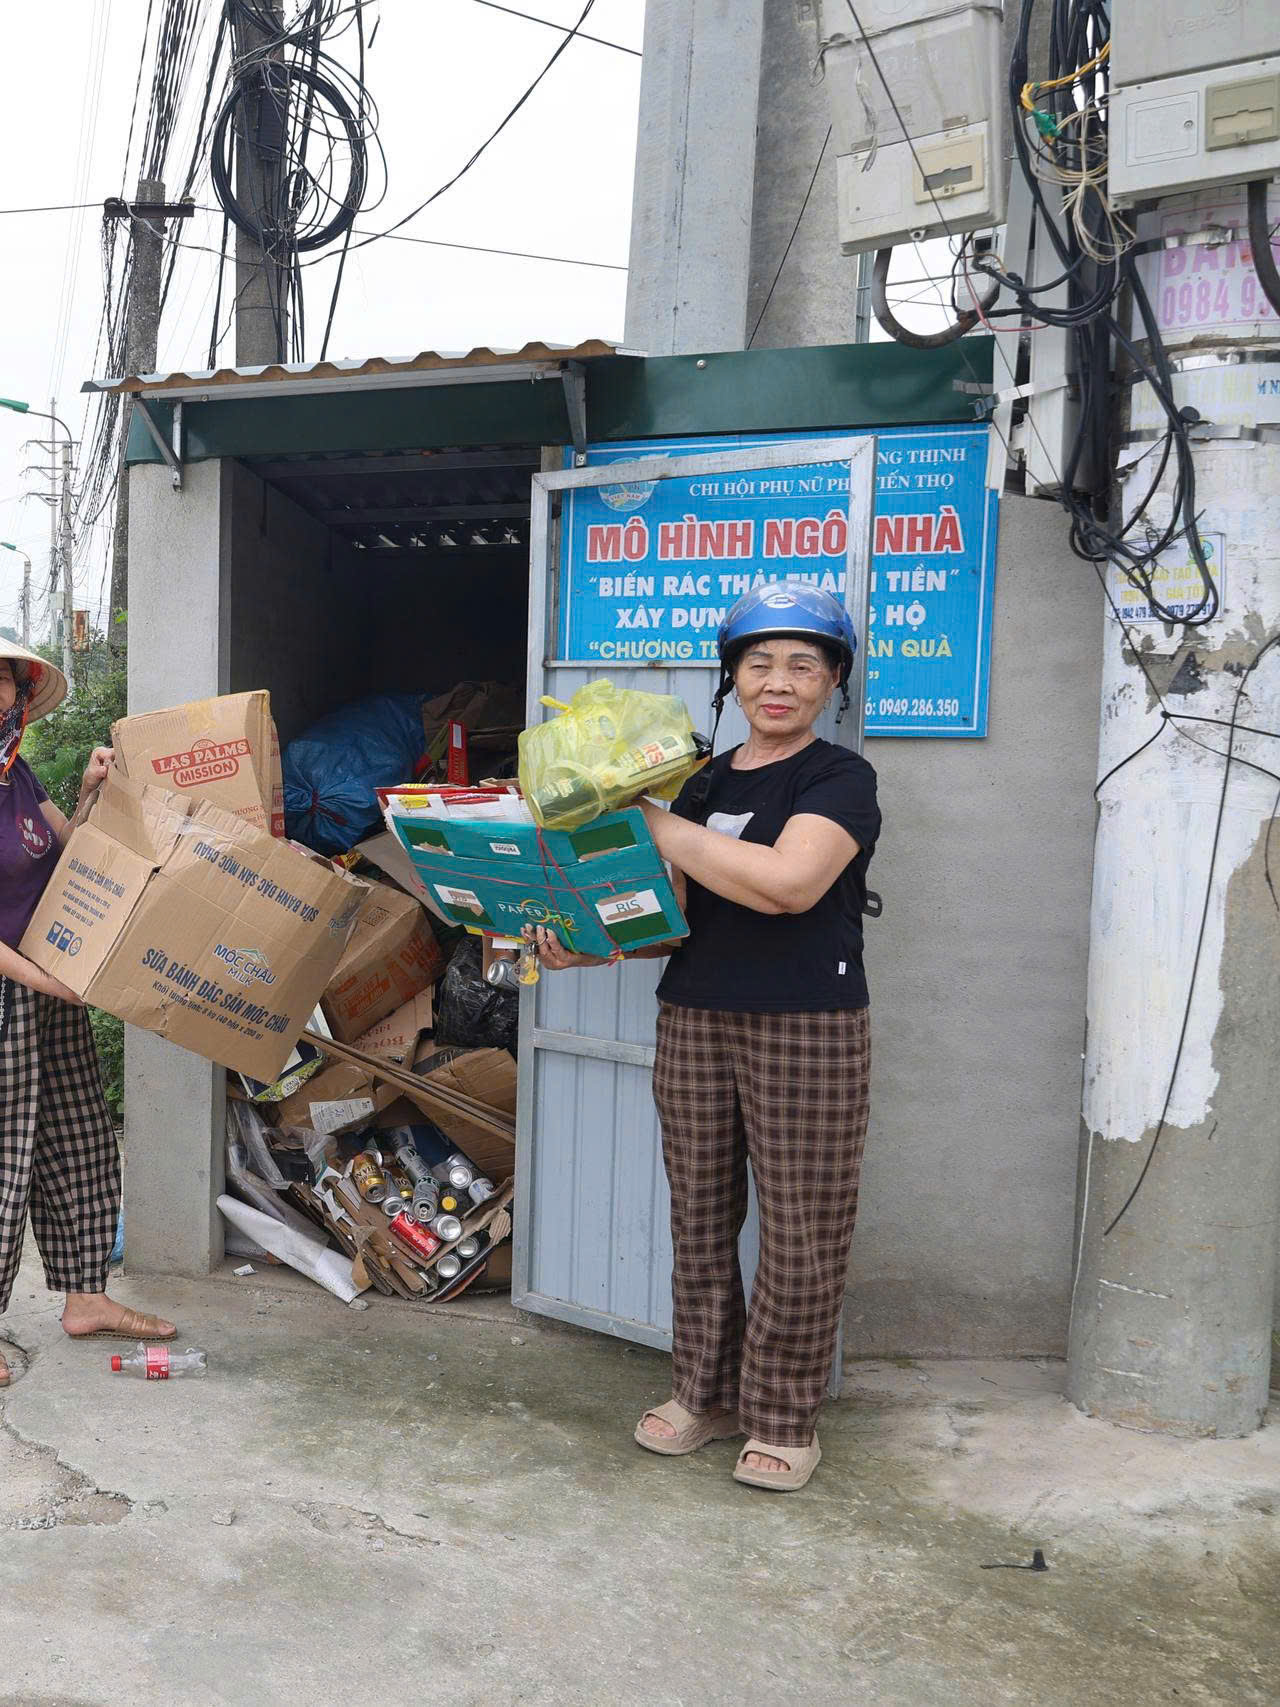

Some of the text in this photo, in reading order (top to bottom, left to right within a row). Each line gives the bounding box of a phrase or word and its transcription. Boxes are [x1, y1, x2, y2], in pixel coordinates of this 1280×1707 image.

[1163, 279, 1229, 326] 0984
[907, 448, 967, 466] THỊNH
[689, 482, 718, 496] CHI
[724, 479, 755, 500] HỘI
[760, 479, 794, 496] PHỤ
[798, 476, 824, 493] NỮ
[915, 473, 955, 491] THỌ
[587, 505, 964, 563] MÔ HÌNH NGÔ NHÀ
[663, 571, 711, 596] RÁC
[616, 604, 665, 628] XÂY
[671, 606, 726, 633] DỰN
[886, 600, 926, 631] HỘ
[900, 634, 953, 658] QUÀ
[879, 699, 959, 717] 0949.286.350
[158, 741, 249, 770] LAS PALMS
[179, 761, 234, 783] MISSION
[498, 903, 545, 918] PAPER
[214, 944, 276, 985] MỘC CHÂU
[227, 967, 254, 986] MILK
[142, 948, 168, 974] SỮA
[166, 963, 201, 991] BÁNH
[196, 980, 223, 1004] ĐẶC
[219, 992, 244, 1014] SẢN
[241, 1003, 269, 1025] MỘC
